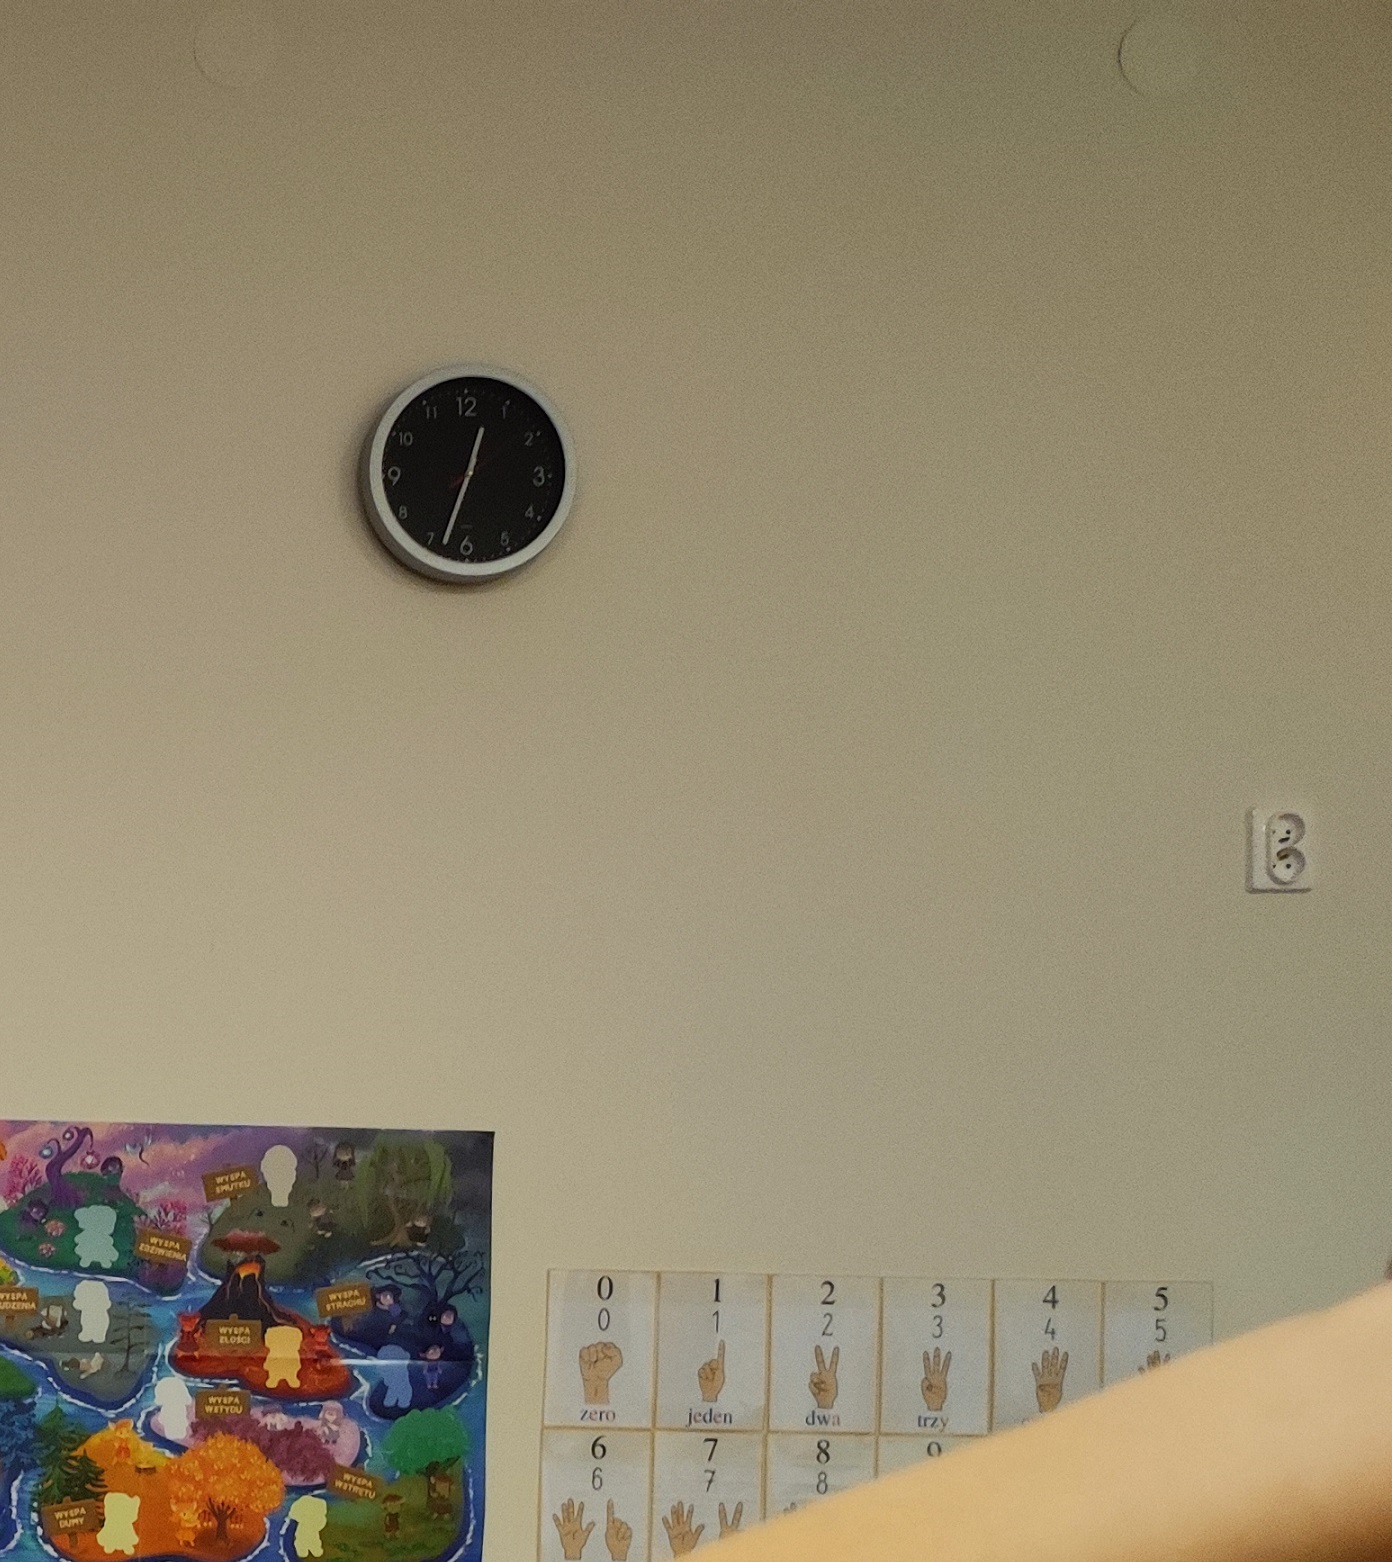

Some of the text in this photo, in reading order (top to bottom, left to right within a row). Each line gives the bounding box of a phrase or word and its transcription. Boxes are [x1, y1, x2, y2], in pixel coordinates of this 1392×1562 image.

[425, 406, 437, 419] 11
[455, 396, 477, 417] 12
[398, 432, 413, 447] 10
[524, 431, 534, 447] 2
[387, 466, 401, 486] 9
[532, 466, 545, 487] 3
[398, 506, 407, 520] 8
[524, 506, 534, 520] 4
[427, 532, 434, 545] 7
[460, 536, 473, 555] 6
[597, 1275, 614, 1301] 0
[713, 1278, 721, 1303] 1
[820, 1281, 836, 1305] 2
[930, 1283, 946, 1308] 3
[1042, 1285, 1059, 1309] 4
[1153, 1286, 1169, 1311] 5
[218, 1326, 250, 1335] WYSPA
[597, 1308, 610, 1331] 0
[712, 1310, 720, 1333] 1
[821, 1313, 834, 1336] 2
[932, 1315, 943, 1339] 3
[1044, 1317, 1056, 1340] 4
[1155, 1318, 1167, 1342] 5
[208, 1396, 240, 1404] WYSPA
[580, 1408, 616, 1422] zero
[686, 1408, 733, 1427] jeden
[805, 1409, 840, 1426] dwa
[917, 1415, 948, 1432] trzy
[591, 1435, 607, 1460] 6
[703, 1437, 718, 1462] 7
[816, 1439, 831, 1464] 8
[592, 1467, 603, 1490] 6
[704, 1469, 716, 1492] 7
[816, 1471, 828, 1494] 8
[54, 1507, 86, 1520] WYSPA
[59, 1517, 84, 1528] DUMY
